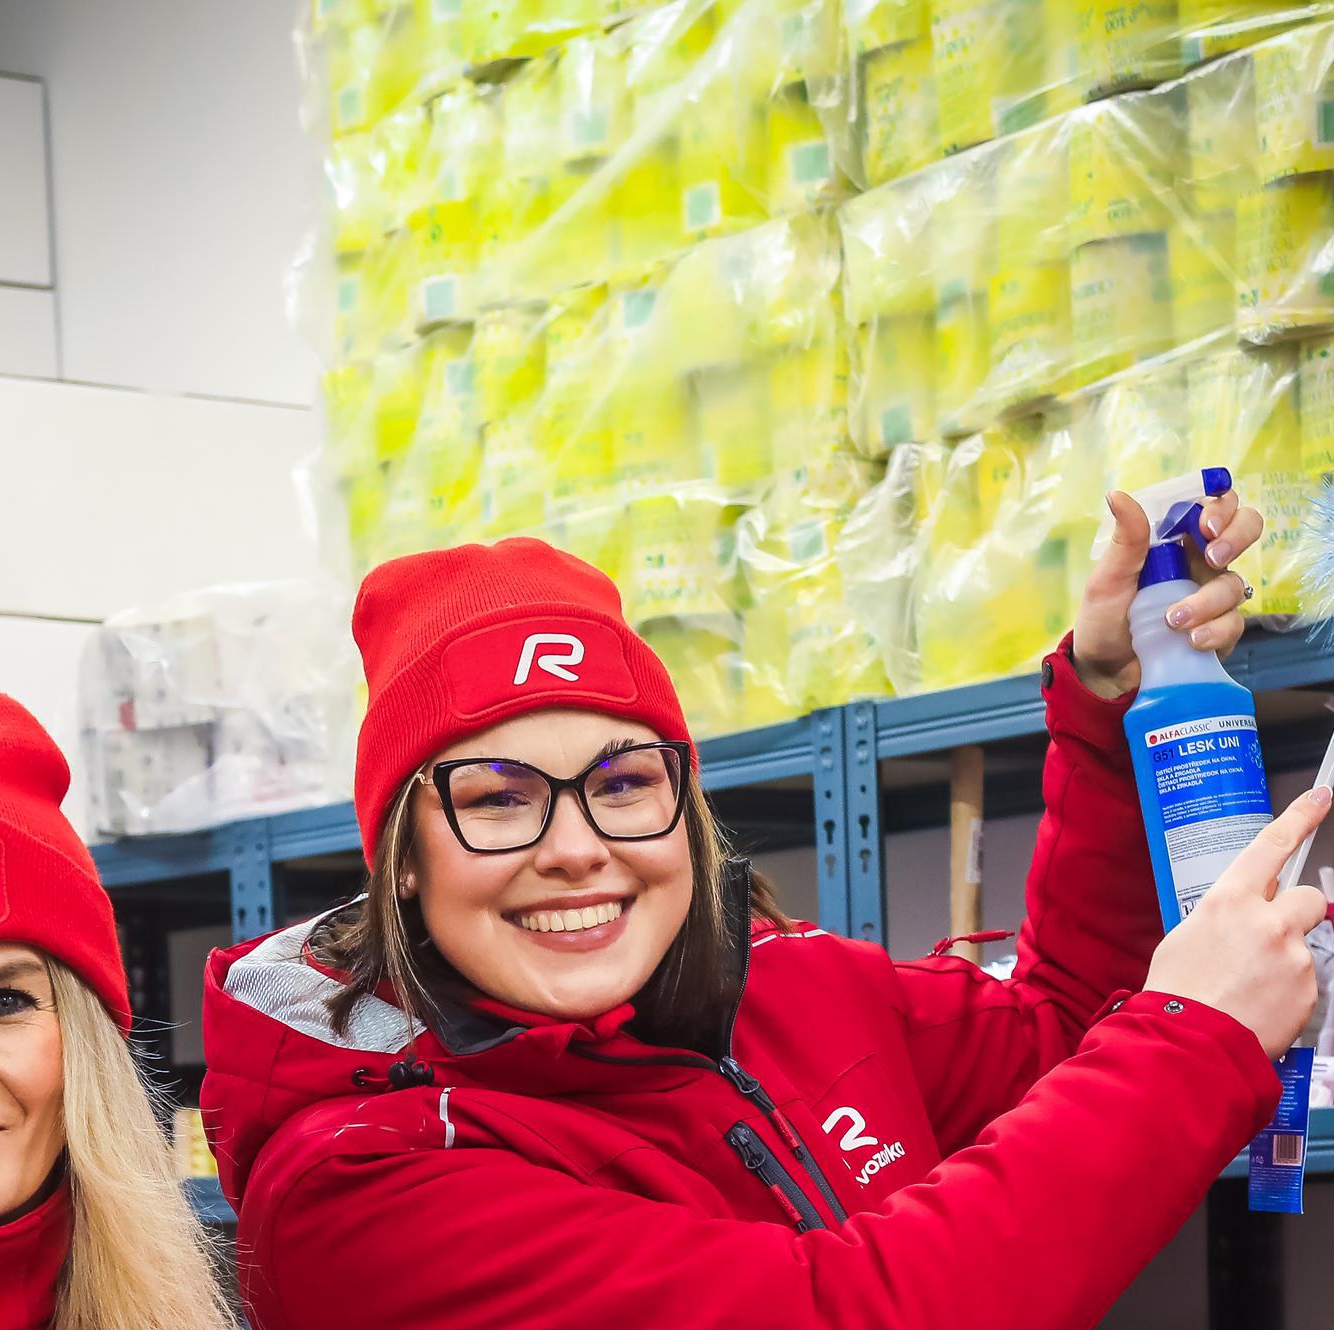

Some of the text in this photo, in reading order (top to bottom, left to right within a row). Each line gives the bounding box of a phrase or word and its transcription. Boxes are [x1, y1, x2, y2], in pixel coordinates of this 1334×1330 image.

[1159, 722, 1211, 742] ALFACLASSIC
[1179, 739, 1216, 757] LESK
[1219, 736, 1240, 749] UNI
